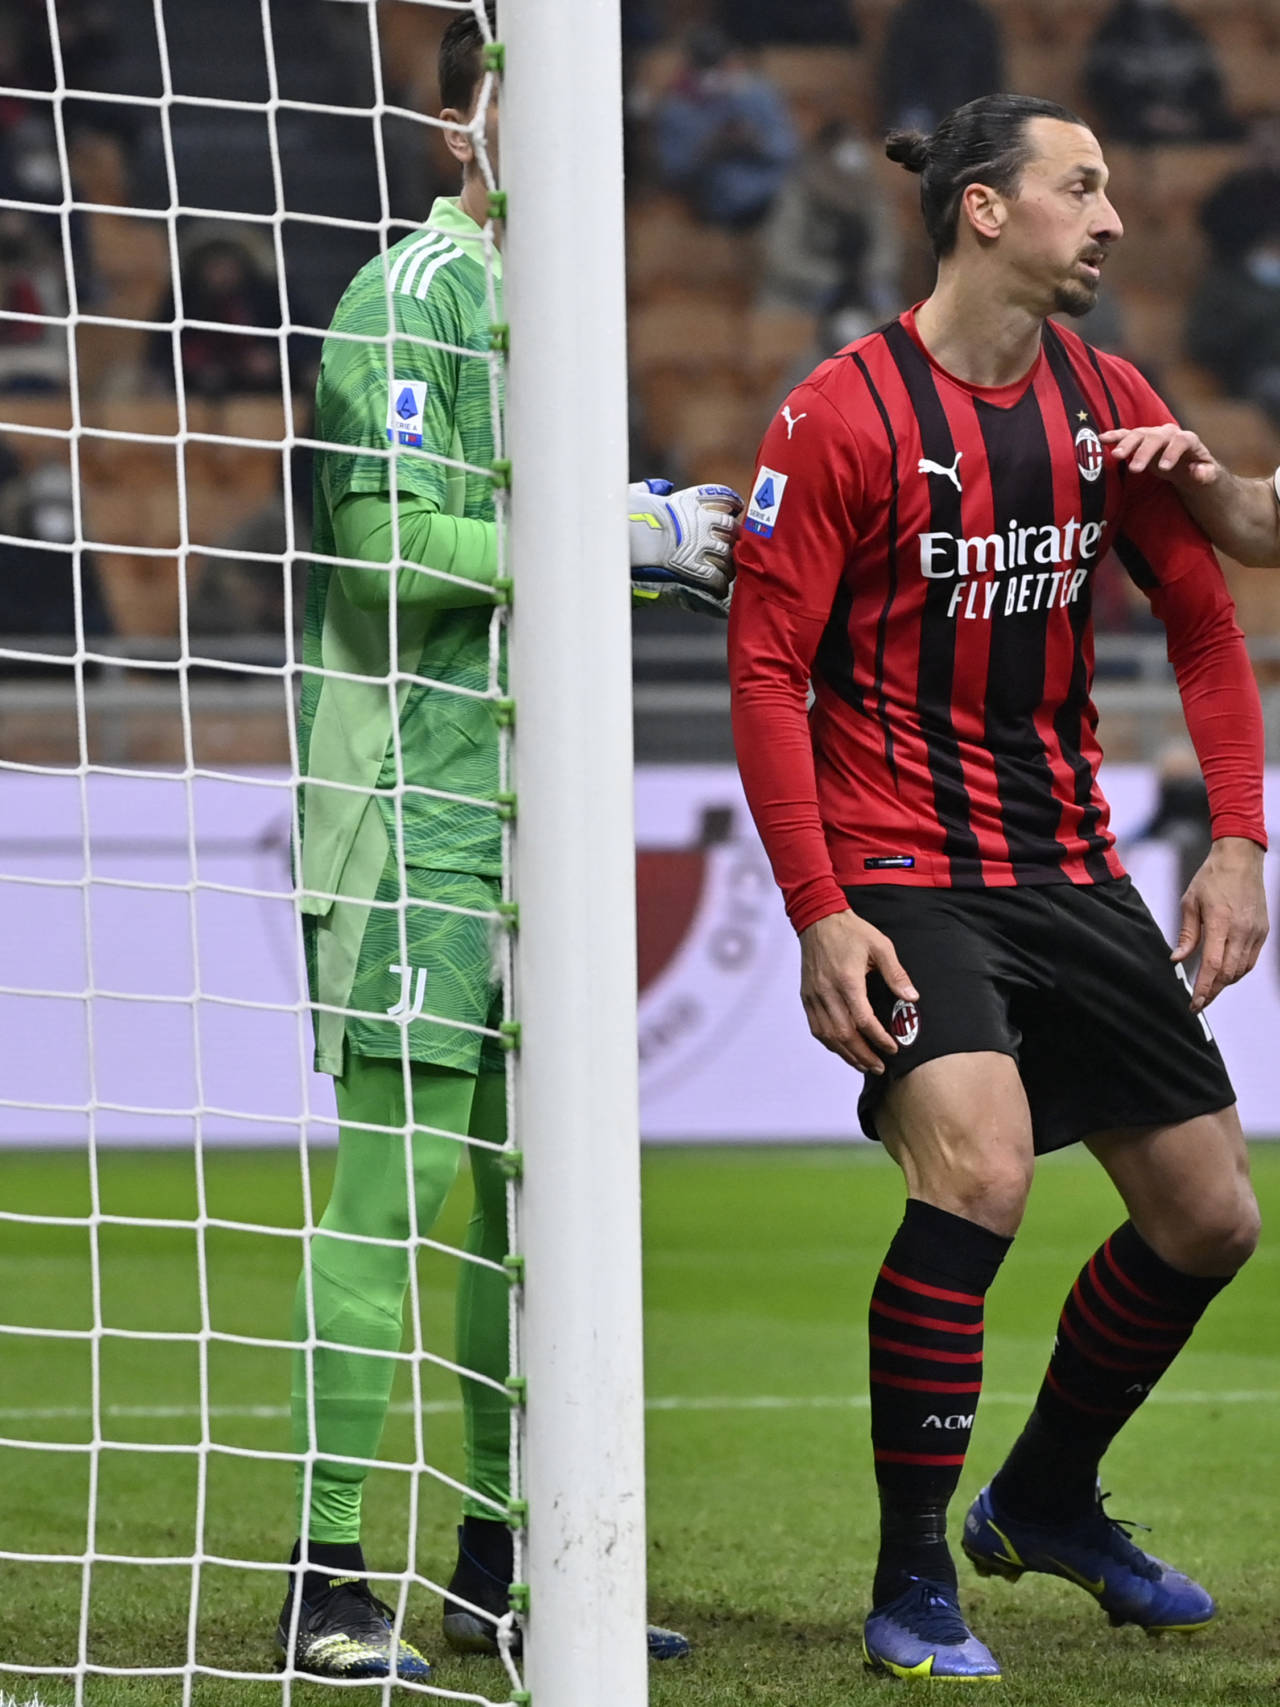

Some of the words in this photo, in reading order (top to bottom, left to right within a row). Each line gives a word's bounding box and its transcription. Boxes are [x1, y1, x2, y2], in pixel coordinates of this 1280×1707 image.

[946, 581, 1000, 620] FLY
[1004, 568, 1088, 617] BETTER
[921, 1414, 974, 1430] ACM
